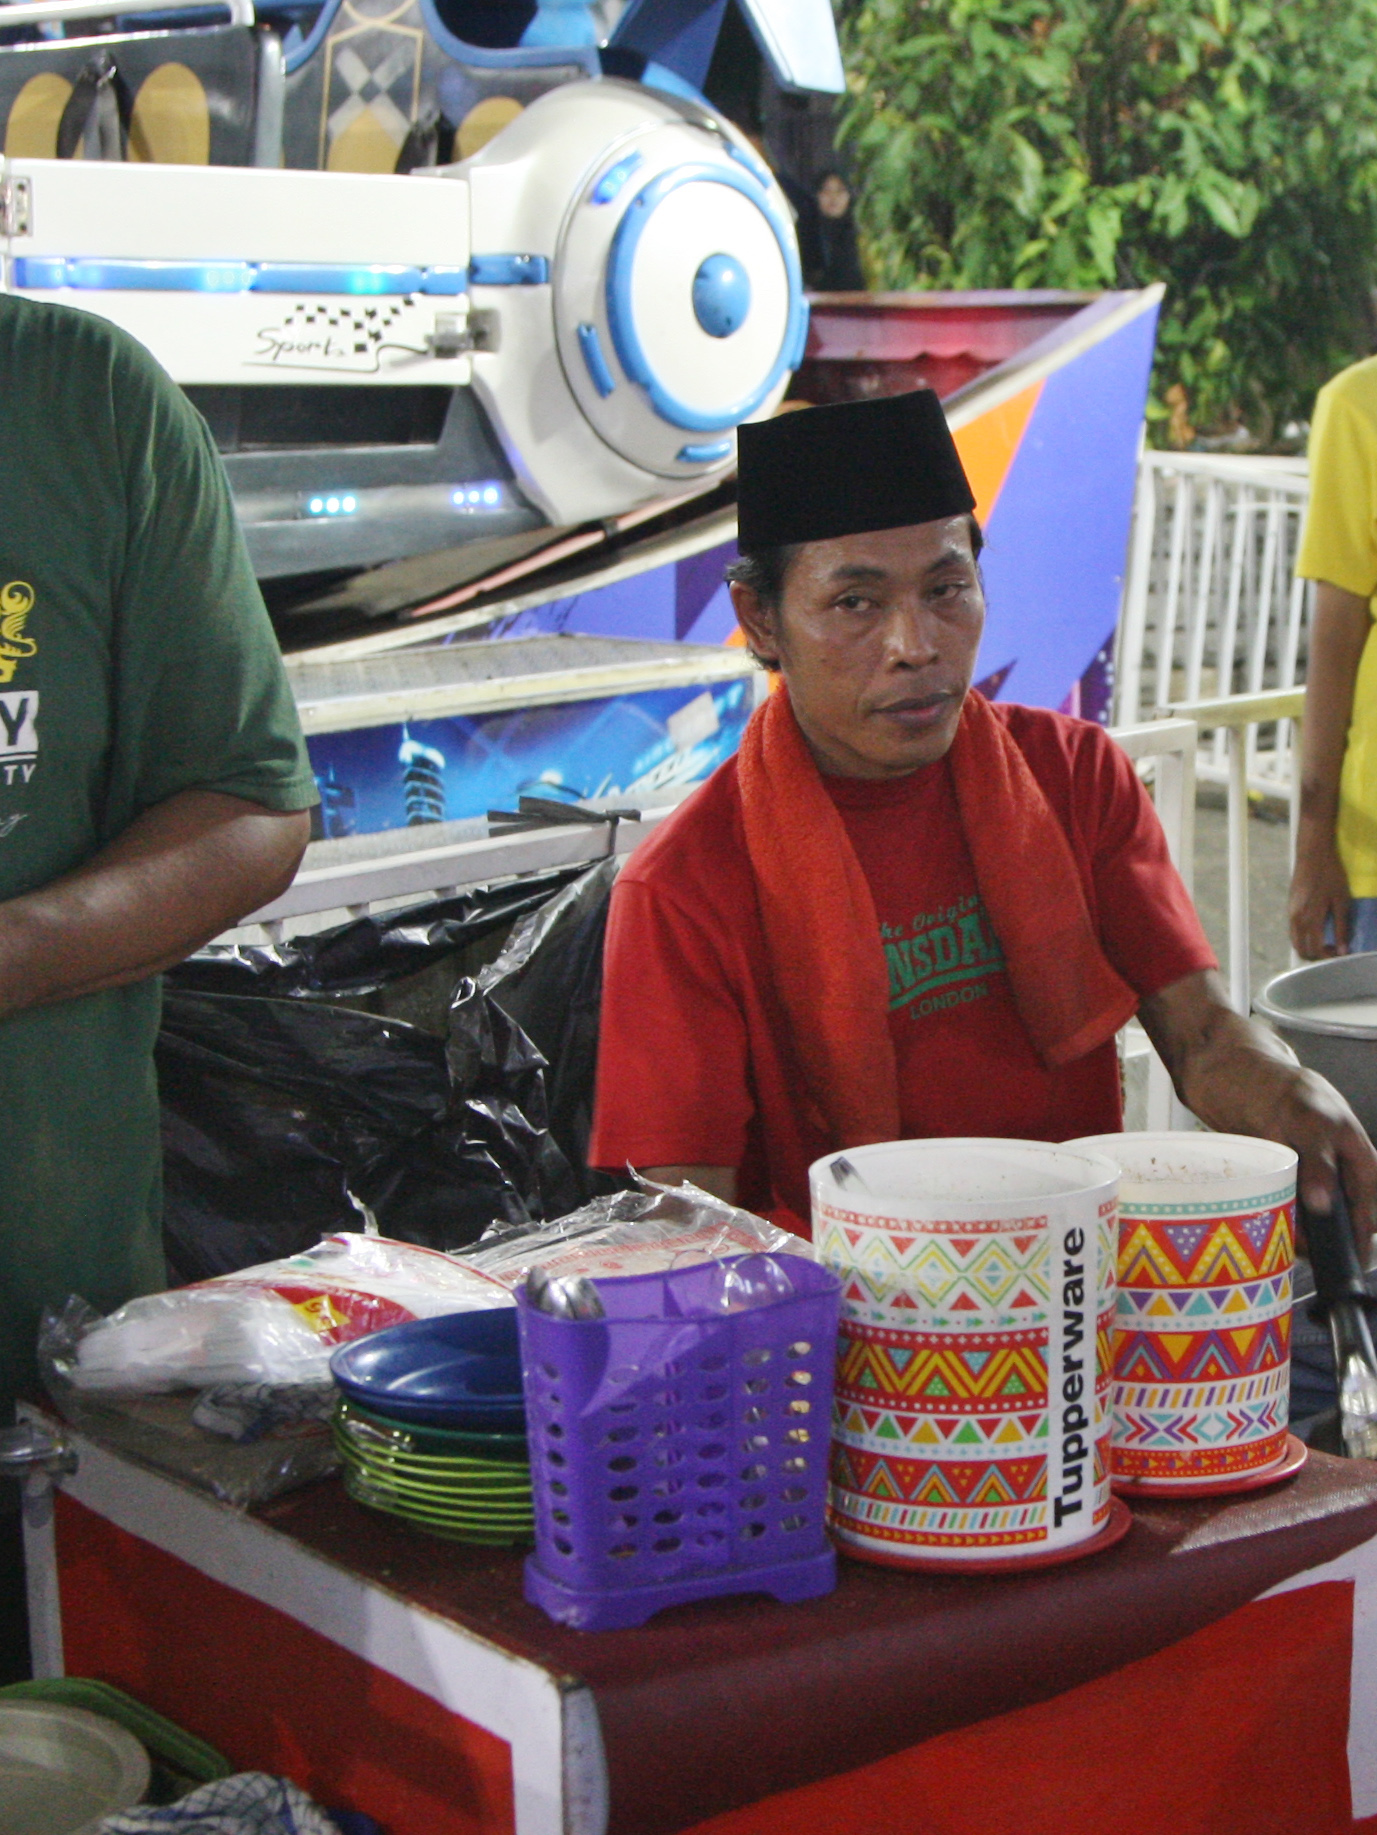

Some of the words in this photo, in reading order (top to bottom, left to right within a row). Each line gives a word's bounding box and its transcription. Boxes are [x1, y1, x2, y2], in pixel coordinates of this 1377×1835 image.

[880, 921, 904, 939] he
[884, 913, 1000, 995] NSDA
[910, 983, 988, 1019] LONDON
[1054, 1226, 1089, 1528] Tupperware
